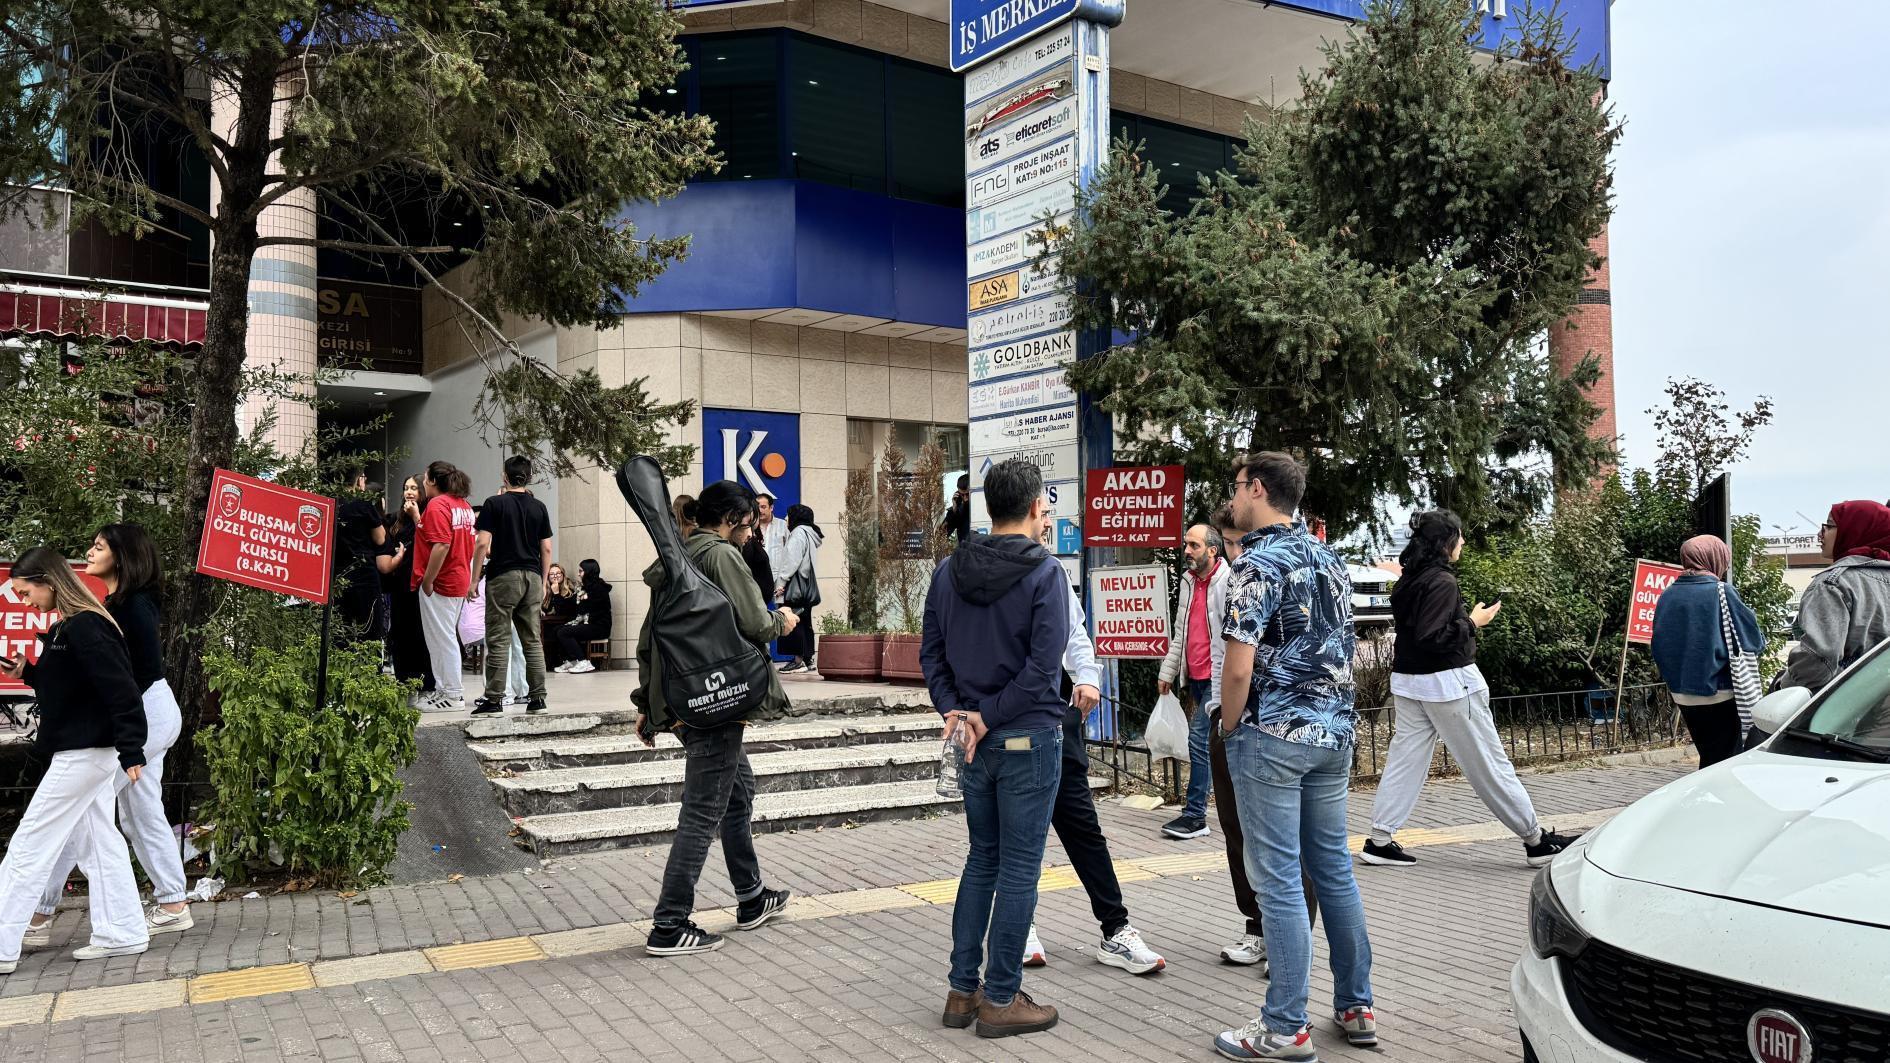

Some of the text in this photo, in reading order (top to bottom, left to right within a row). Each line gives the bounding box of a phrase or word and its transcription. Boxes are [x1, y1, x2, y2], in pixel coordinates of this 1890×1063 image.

[960, 0, 1068, 55] İŞ MERKE
[1015, 107, 1071, 141] eticaretsoft
[980, 138, 1000, 157] ats
[1013, 156, 1039, 173] PROJE
[1040, 144, 1070, 163] İNŞAAT
[1016, 159, 1068, 185] KAT:9 NO:115
[993, 333, 1072, 364] GOLDBANK
[1024, 415, 1048, 426] HABER
[1049, 410, 1074, 422] AJANSI
[1103, 469, 1166, 491] AKAD
[1092, 491, 1175, 510] GÜVENLİK
[239, 508, 297, 535] BURSAM
[1062, 525, 1074, 536] KAT
[1101, 511, 1165, 528] EĞİTİMİ
[213, 514, 323, 557] ÖZEL GÜVENLİK
[1111, 533, 1151, 542] 12. KAT
[240, 540, 288, 564] KURSU
[236, 556, 290, 582] (8.KAT)
[1100, 572, 1156, 592] MEVLÜT
[1106, 597, 1153, 613] ERKEK
[1098, 616, 1165, 635] KUAFÖRÜ
[688, 693, 715, 708] MERT
[717, 682, 750, 700] MÜZİK
[1760, 1024, 1798, 1060] FIAT
